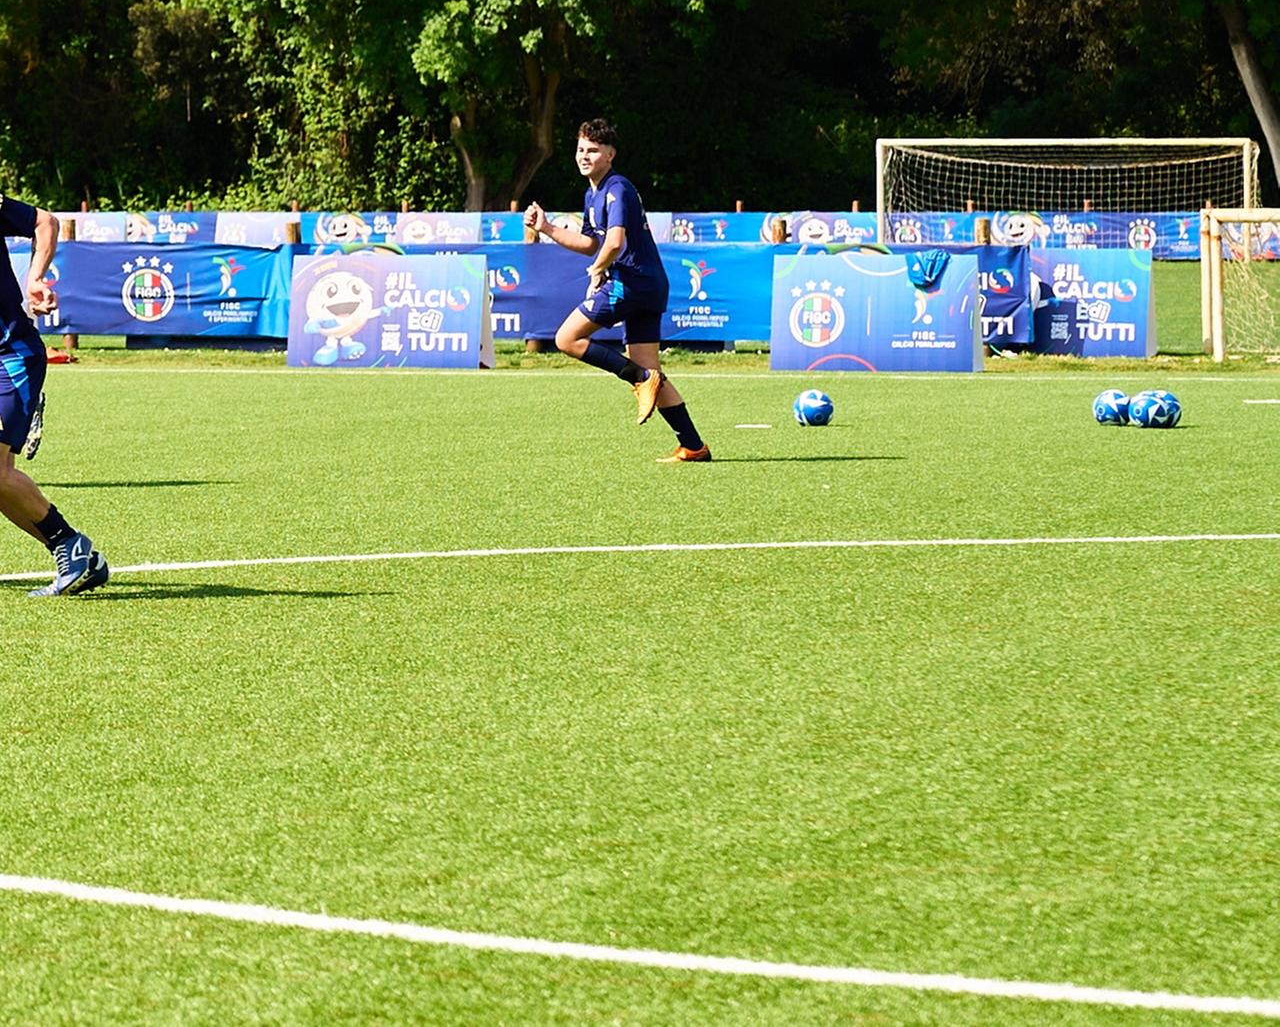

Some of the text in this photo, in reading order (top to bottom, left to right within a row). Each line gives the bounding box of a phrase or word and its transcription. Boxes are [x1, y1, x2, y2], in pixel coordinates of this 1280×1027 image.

[385, 272, 416, 290] #IL
[1053, 263, 1084, 281] #IL
[490, 313, 520, 332] TTI
[803, 311, 831, 324] FIGC
[981, 316, 1014, 336] TTI
[912, 331, 936, 340] FIGC
[1076, 322, 1135, 342] TUTTI
[407, 333, 468, 352] TUTTI
